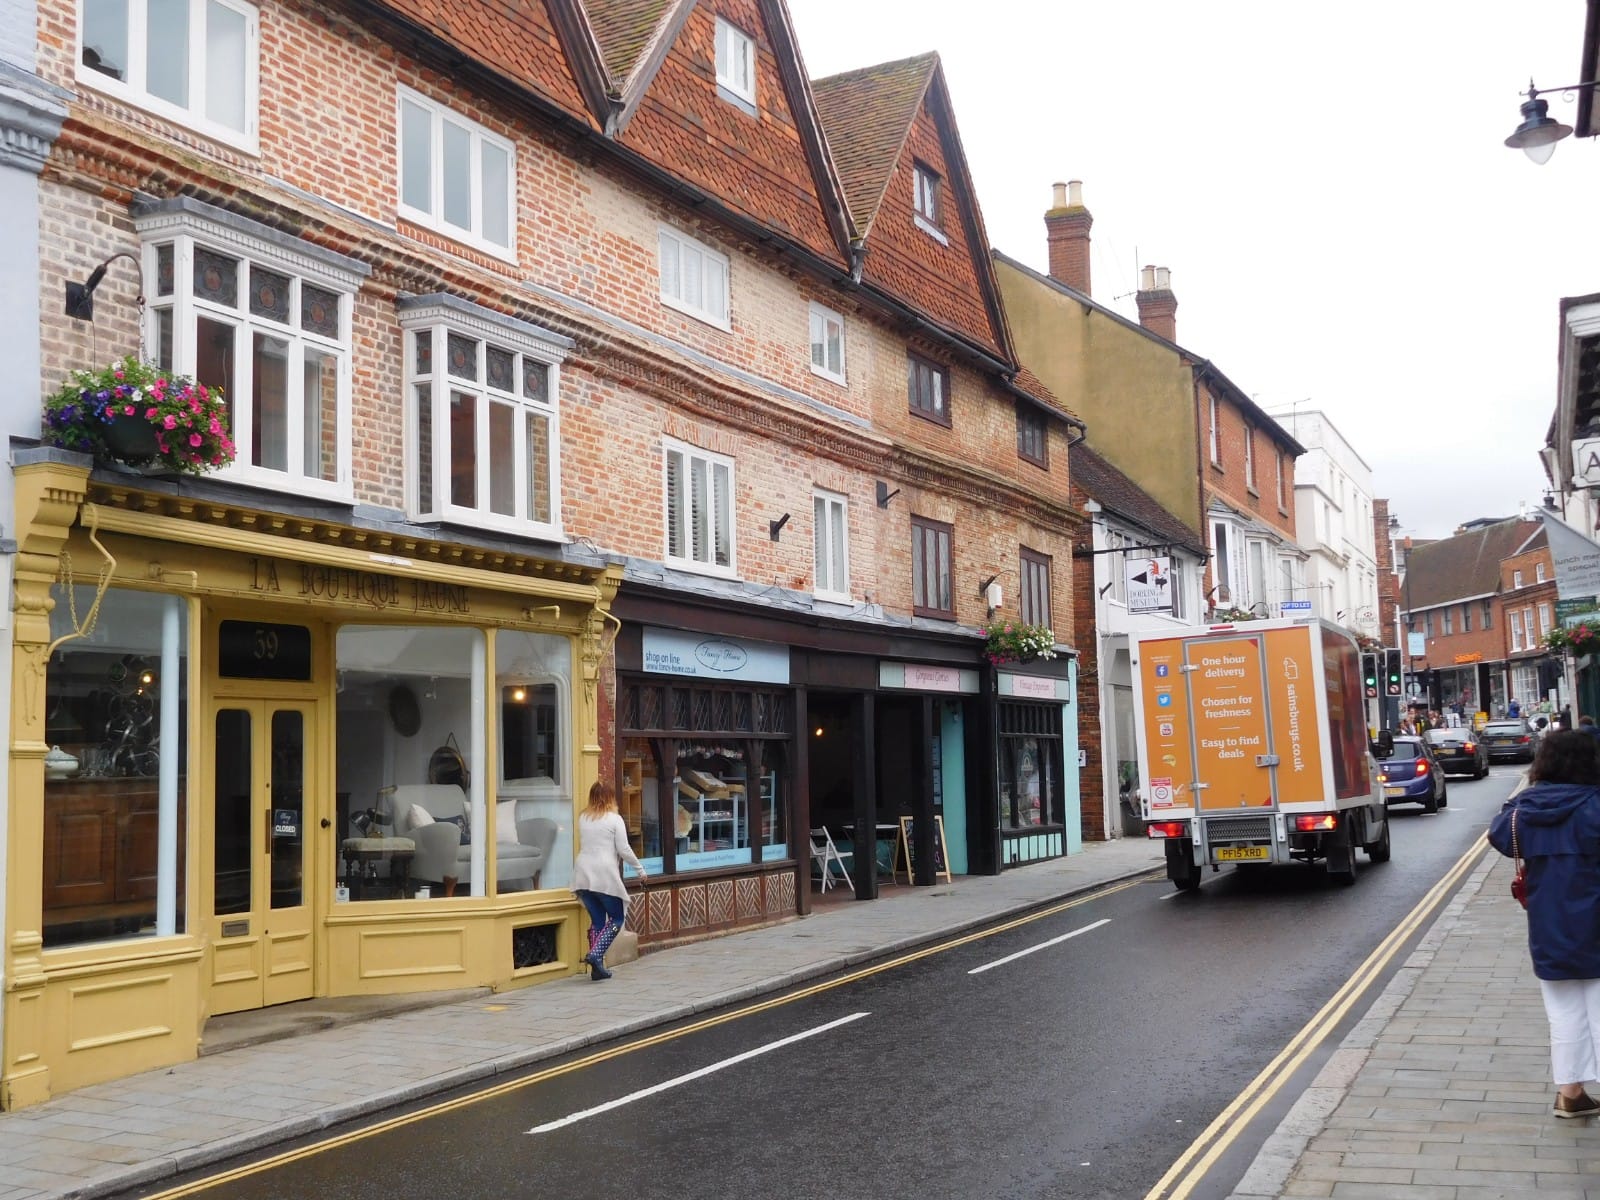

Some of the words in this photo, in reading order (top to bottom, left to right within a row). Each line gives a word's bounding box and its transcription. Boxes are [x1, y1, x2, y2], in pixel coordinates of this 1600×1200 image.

[1555, 556, 1580, 565] lunch
[249, 557, 281, 592] LA
[298, 563, 400, 610] BOUTIQUE
[411, 579, 470, 614] JAUNE
[1130, 589, 1159, 600] DORKING
[1130, 598, 1159, 607] MUSEUM
[645, 650, 660, 663] shop
[661, 655, 669, 663] on
[669, 653, 681, 665] line
[1202, 657, 1221, 666] One
[1222, 655, 1246, 665] hour
[1205, 668, 1245, 678] delivery
[1201, 697, 1237, 707] Chosen
[1238, 695, 1253, 705] for
[1205, 708, 1251, 719] freshness
[1287, 683, 1305, 772] sainsburys.co.uk
[1201, 739, 1225, 749] Easy
[1226, 738, 1238, 746] to
[1239, 735, 1260, 745] find
[1218, 749, 1245, 759] deals
[1222, 848, 1242, 858] PF15
[1245, 848, 1262, 857] XRD
